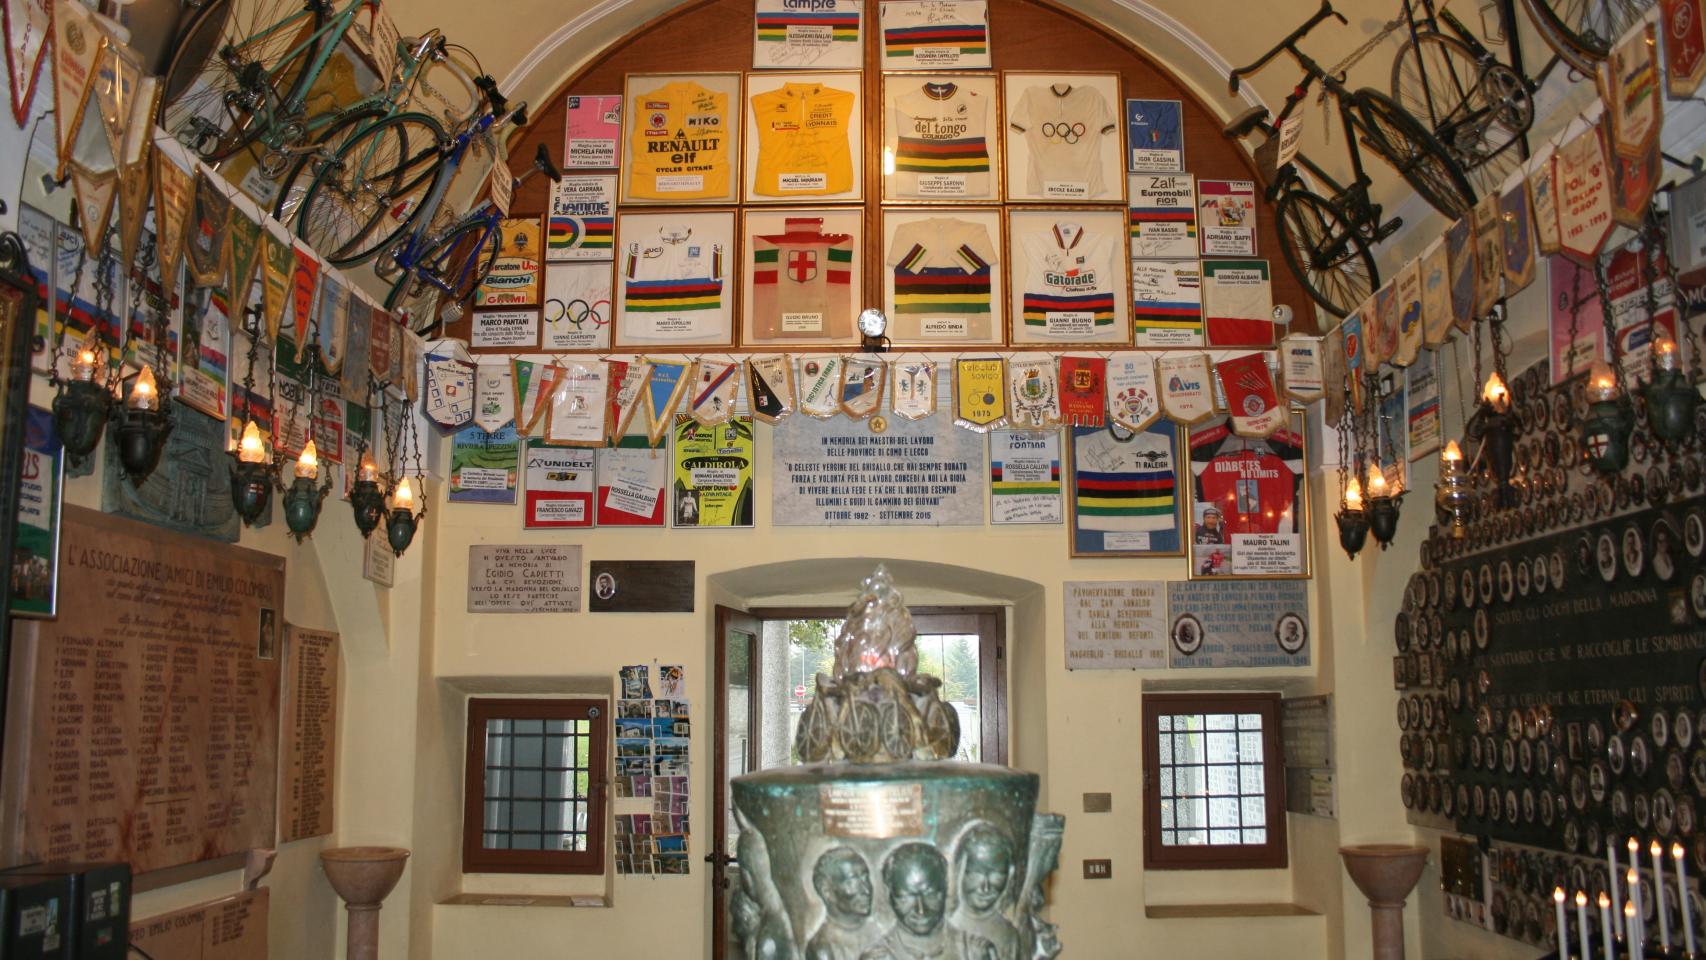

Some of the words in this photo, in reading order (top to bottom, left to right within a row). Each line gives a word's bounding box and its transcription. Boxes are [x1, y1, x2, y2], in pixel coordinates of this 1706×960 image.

[688, 116, 720, 126] MIKO
[915, 121, 930, 133] del
[935, 121, 967, 137] tongo
[647, 138, 721, 153] RENAULT
[670, 152, 697, 163] elf
[1150, 177, 1173, 188] Zalf
[521, 261, 538, 271] Uno
[485, 276, 530, 285] Bianchi
[1046, 273, 1095, 285] Gatorade
[821, 437, 828, 445] IN
[830, 437, 855, 445] MEMORIA
[858, 437, 867, 445] DEI
[870, 437, 896, 445] MAESTRI
[897, 437, 908, 445] DEL
[910, 437, 934, 445] LAVORO
[827, 448, 845, 456] DELLE
[847, 448, 876, 456] PROVINCE
[878, 448, 884, 456] DI
[886, 448, 902, 456] COMO
[910, 448, 929, 456] LECCO
[794, 463, 820, 471] CELESTE
[823, 463, 847, 471] VERGINE
[849, 463, 860, 471] DEL
[906, 463, 917, 471] HAI
[919, 463, 942, 471] SEMPRE
[944, 463, 968, 471] DONATO
[1214, 460, 1261, 473] DIABETES
[791, 474, 810, 482] FORZA
[847, 474, 858, 482] PER
[860, 474, 867, 482] IL
[895, 474, 920, 482] CONCEDI
[921, 474, 926, 482] A
[928, 474, 938, 482] NOI
[940, 474, 948, 482] LA
[950, 474, 966, 482] GIOIA
[1240, 470, 1252, 478] NO
[1253, 470, 1279, 478] LIMITS
[799, 486, 806, 494] DI
[808, 486, 829, 494] VIVERE
[831, 486, 849, 494] NELLA
[851, 486, 866, 494] FEDE
[885, 486, 896, 494] CHE
[898, 486, 904, 494] IL
[906, 486, 929, 494] NOSTRO
[931, 486, 957, 494] ESEMPIO
[816, 498, 842, 506] ILLUMINI
[850, 498, 866, 506] GUIDI
[867, 498, 873, 506] IL
[875, 498, 901, 506] CAMMINO
[903, 498, 913, 506] DEI
[825, 511, 852, 519] OTTOBRE
[880, 511, 914, 519] SETTEMBRE
[915, 511, 932, 519] 2015
[486, 569, 514, 578] EGIDIO
[522, 569, 564, 578] CAPIETTI
[207, 571, 234, 593] EMILIO
[1609, 587, 1657, 607] MADONNA
[1577, 640, 1633, 658] RACCOGLIE
[1635, 637, 1648, 653] LE
[1584, 688, 1621, 705] ETERNA
